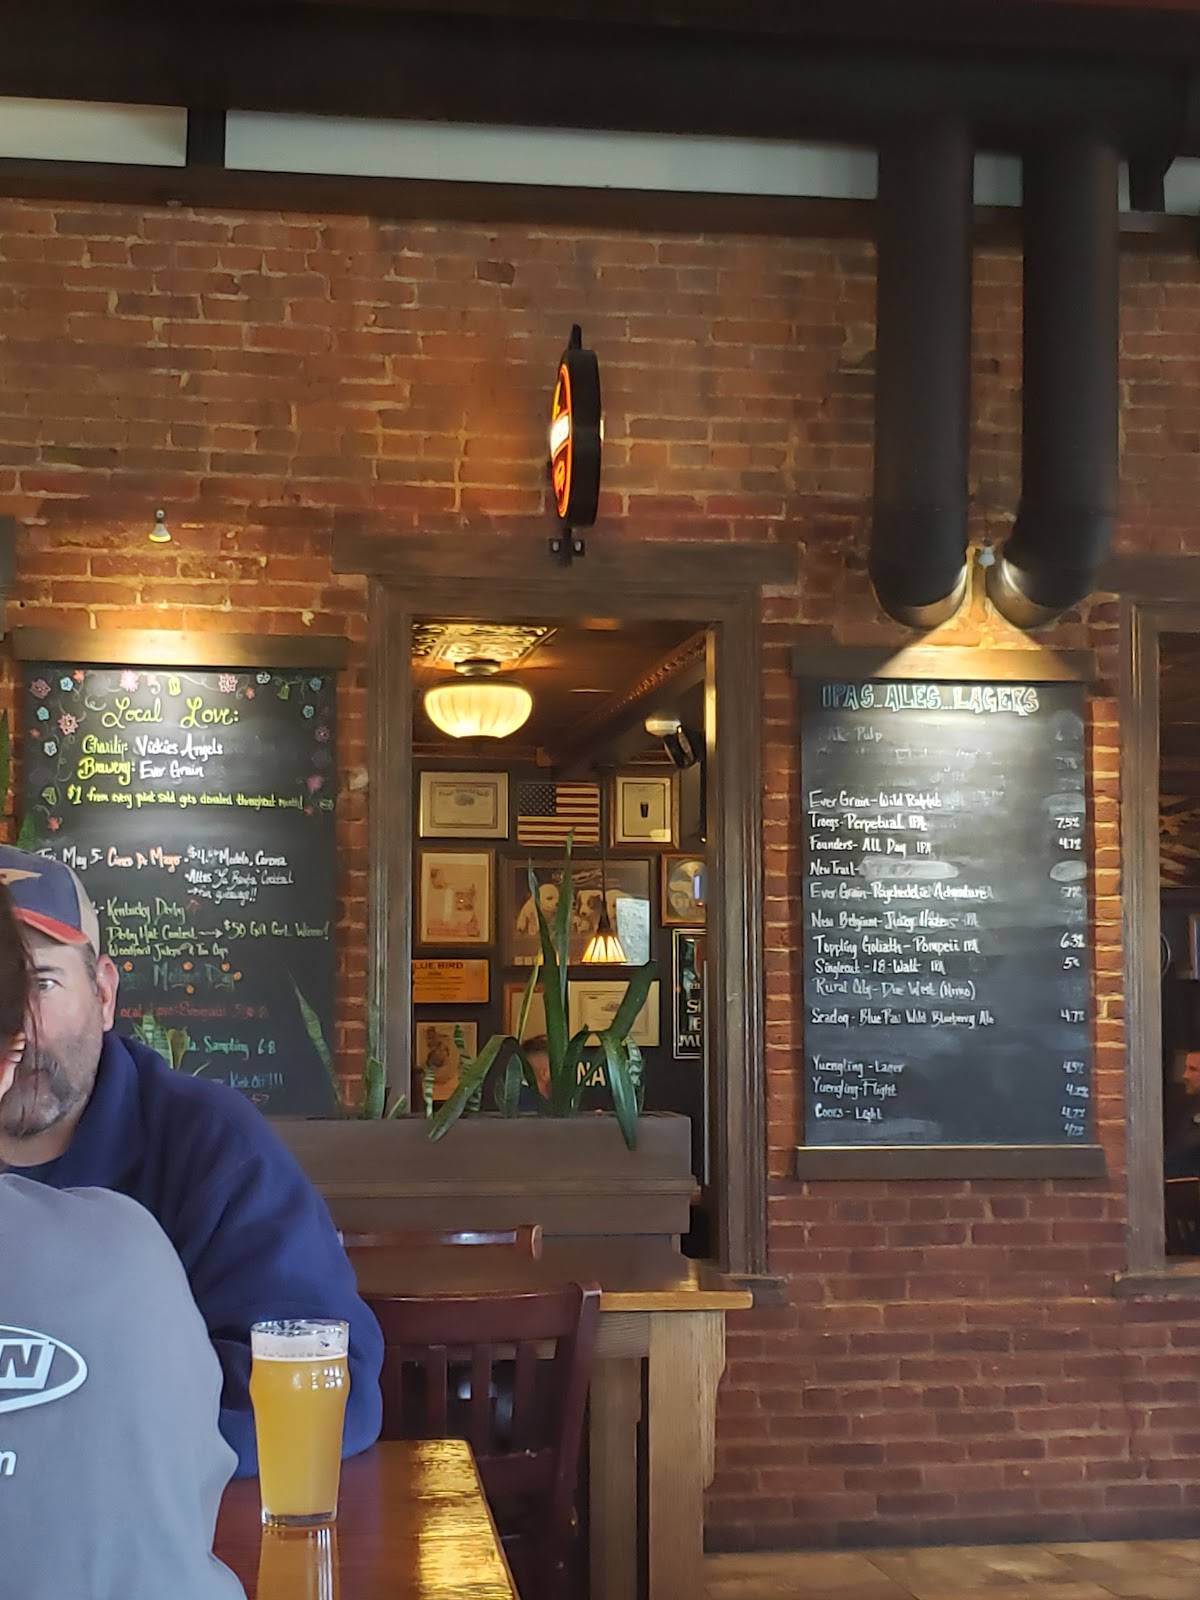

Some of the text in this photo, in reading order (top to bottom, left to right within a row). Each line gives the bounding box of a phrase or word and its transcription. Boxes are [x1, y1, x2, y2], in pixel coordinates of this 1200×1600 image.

[102, 696, 239, 728] Local Love:
[169, 763, 205, 779] Grain
[87, 787, 109, 802] from
[862, 838, 882, 852] All
[887, 841, 908, 858] Day
[106, 896, 152, 926] Kentucky
[814, 934, 858, 960] Toppling
